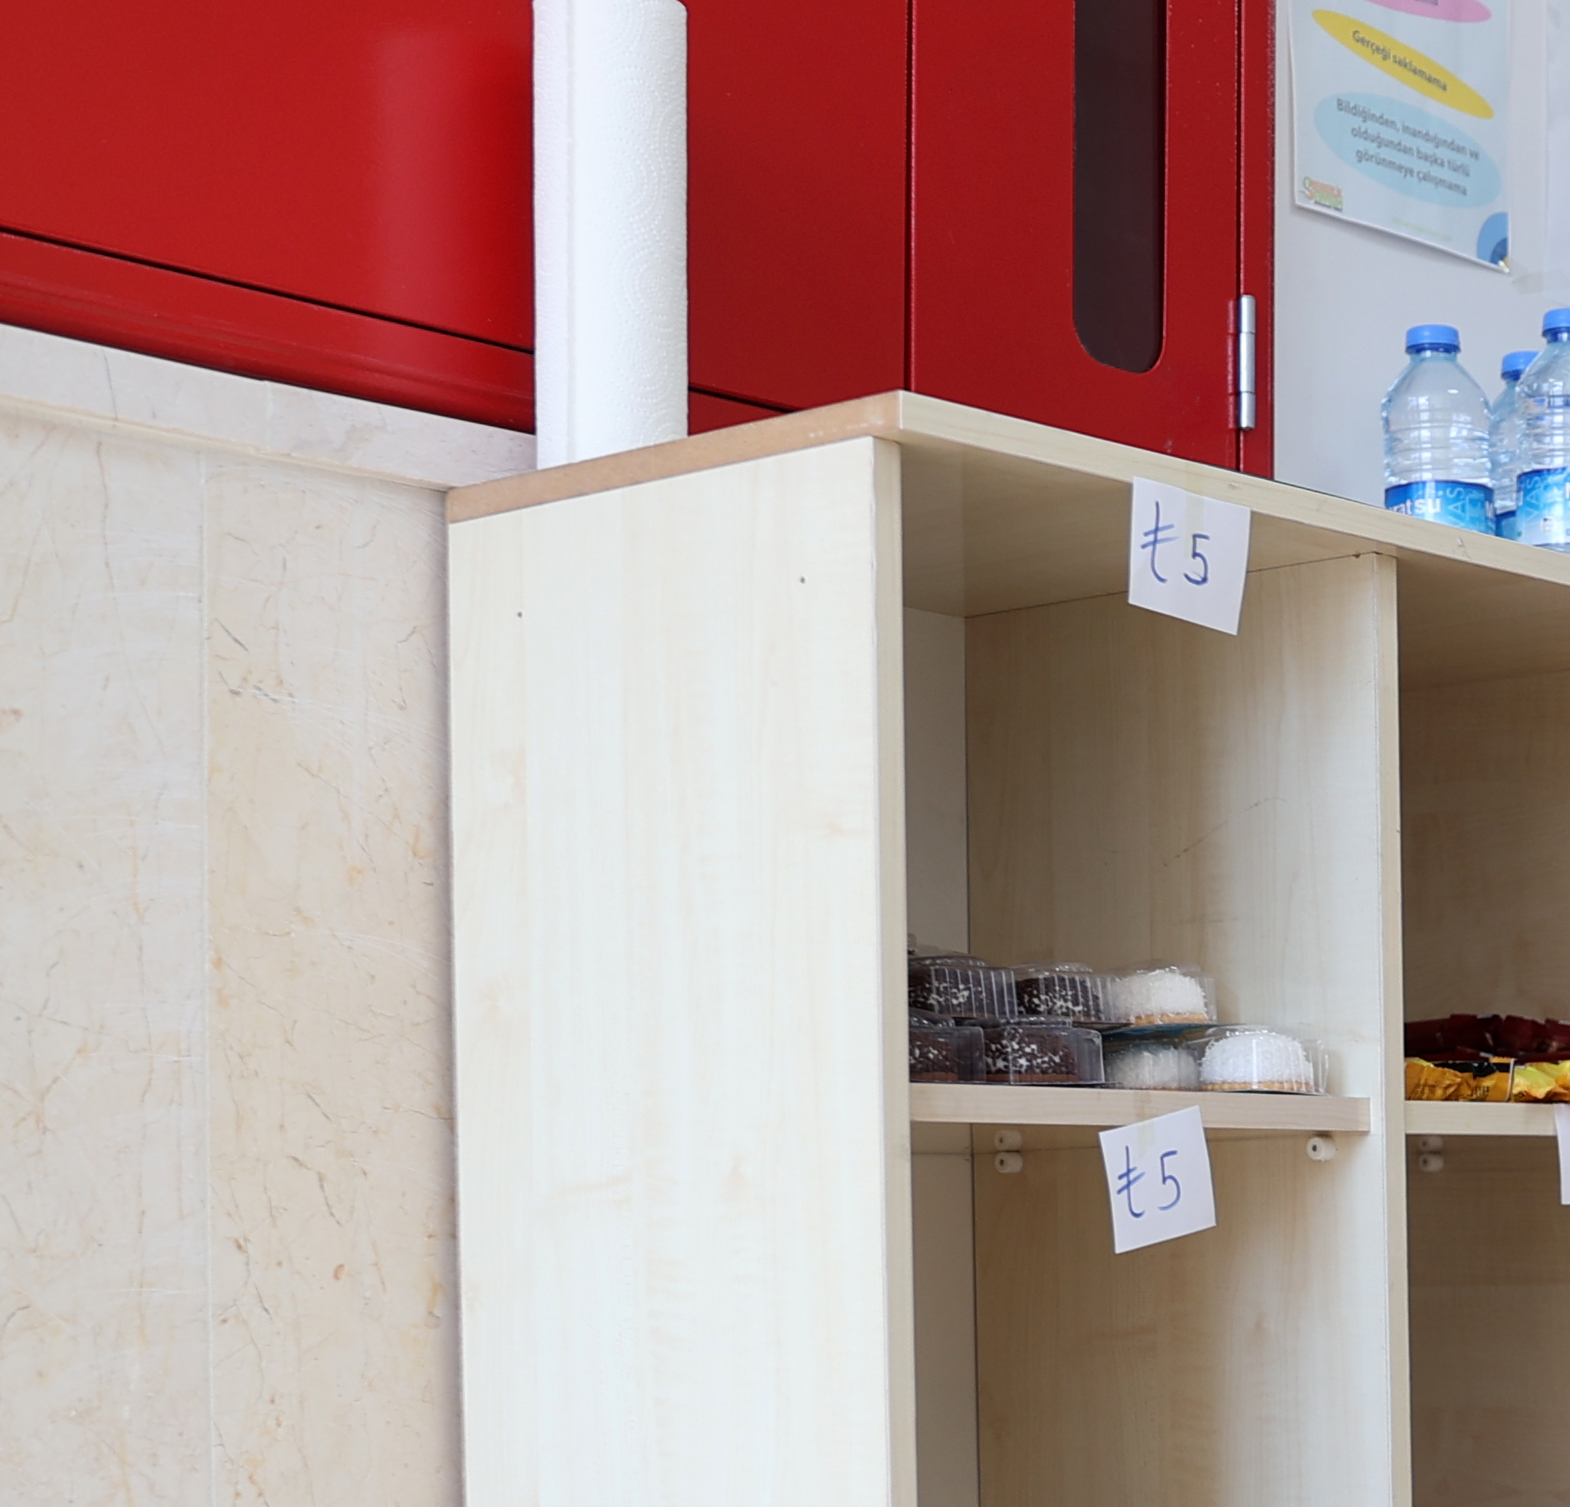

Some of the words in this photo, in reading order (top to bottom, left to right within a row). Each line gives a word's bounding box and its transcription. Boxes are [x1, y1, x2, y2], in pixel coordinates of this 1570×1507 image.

[1352, 30, 1391, 60] Gerçeği
[1392, 53, 1448, 92] saklamama
[1468, 148, 1480, 161] ve
